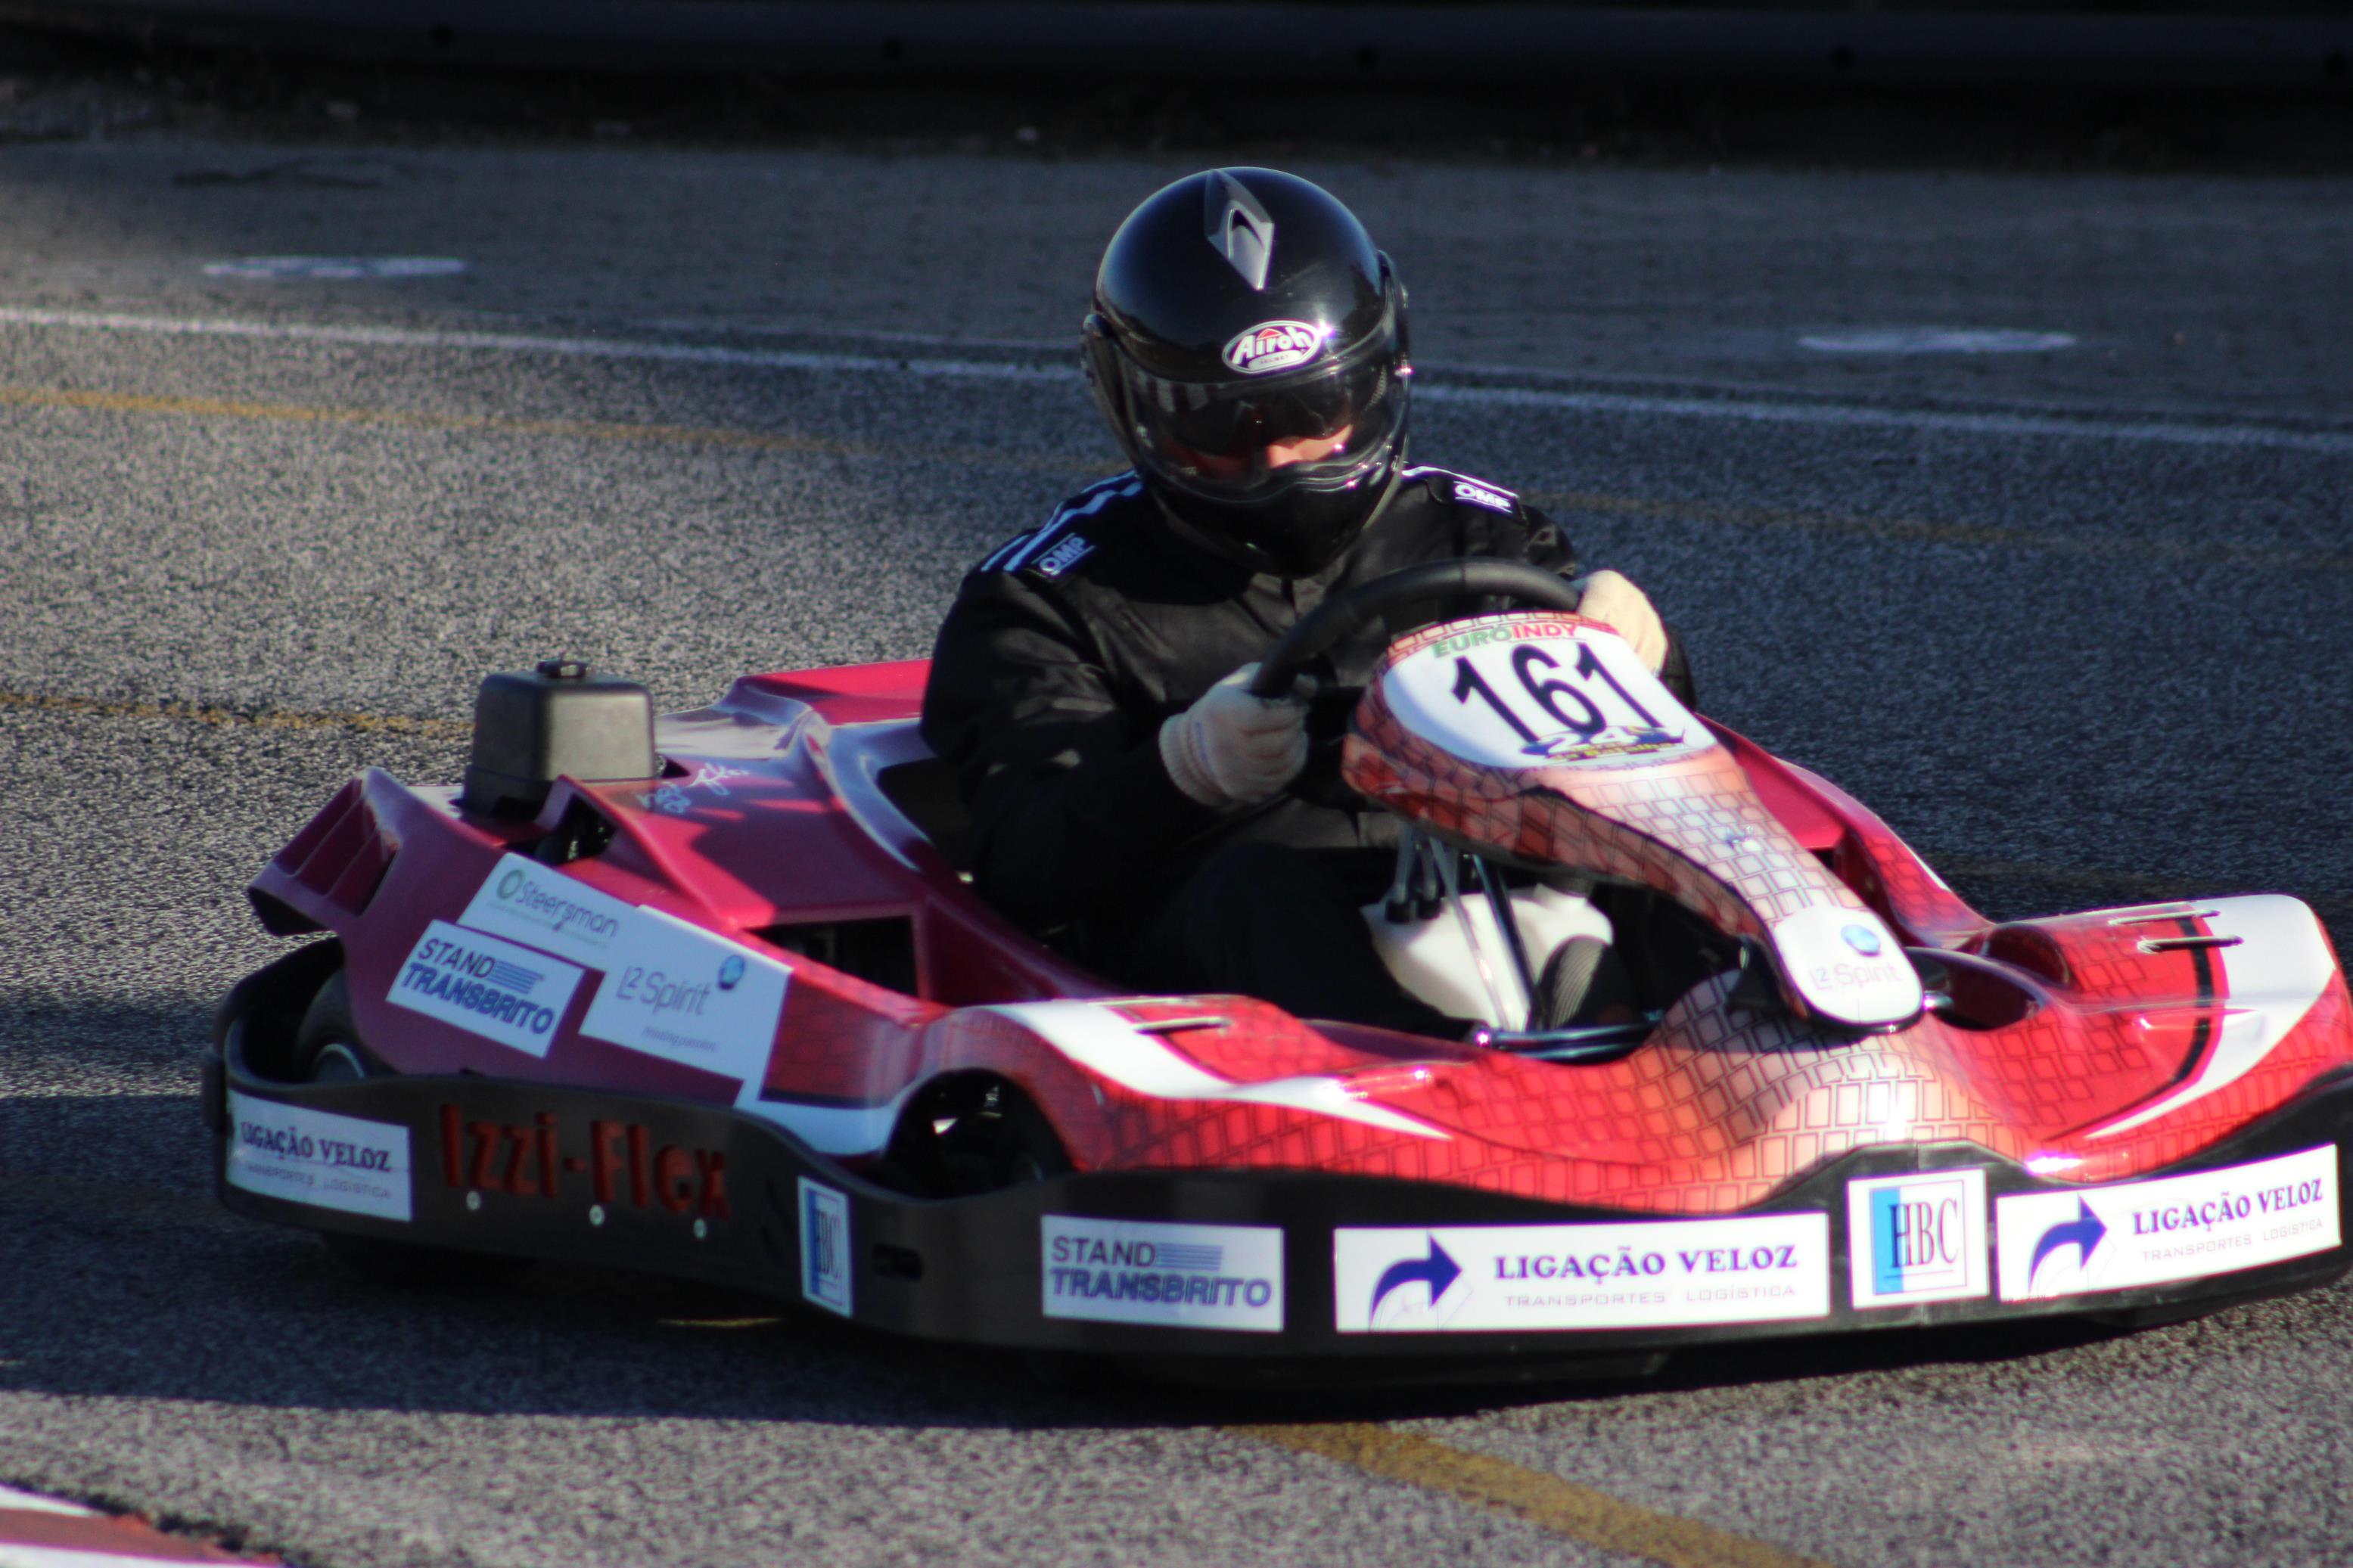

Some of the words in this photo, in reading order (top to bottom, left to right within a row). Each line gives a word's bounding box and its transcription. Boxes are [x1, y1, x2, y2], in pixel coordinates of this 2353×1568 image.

[1232, 326, 1313, 365] Airoh
[1455, 484, 1511, 507] OMP
[1040, 536, 1086, 573] OMP
[1451, 641, 1664, 744] 161
[515, 880, 619, 939] Steersman
[418, 938, 496, 979] STAND
[402, 961, 555, 1035] TRANSBRITO
[640, 970, 713, 1017] Spirit
[319, 1138, 392, 1172] VELOZ
[440, 1103, 732, 1220] Izzi-Flex
[2132, 1191, 2251, 1234] LIGAÇÃO
[2257, 1178, 2323, 1213] VELOZ
[1052, 1236, 1156, 1268] STAND
[1888, 1197, 1960, 1268] HBC
[2142, 1233, 2252, 1263] TRANSPORTES
[1494, 1246, 1666, 1285] LIGAÇÃO
[1677, 1244, 1798, 1273] VELOZ
[1050, 1266, 1272, 1308] TRANSBRITO
[1503, 1290, 1665, 1309] TRANSPORTES
[1686, 1284, 1796, 1302] LOGÍSTICA
